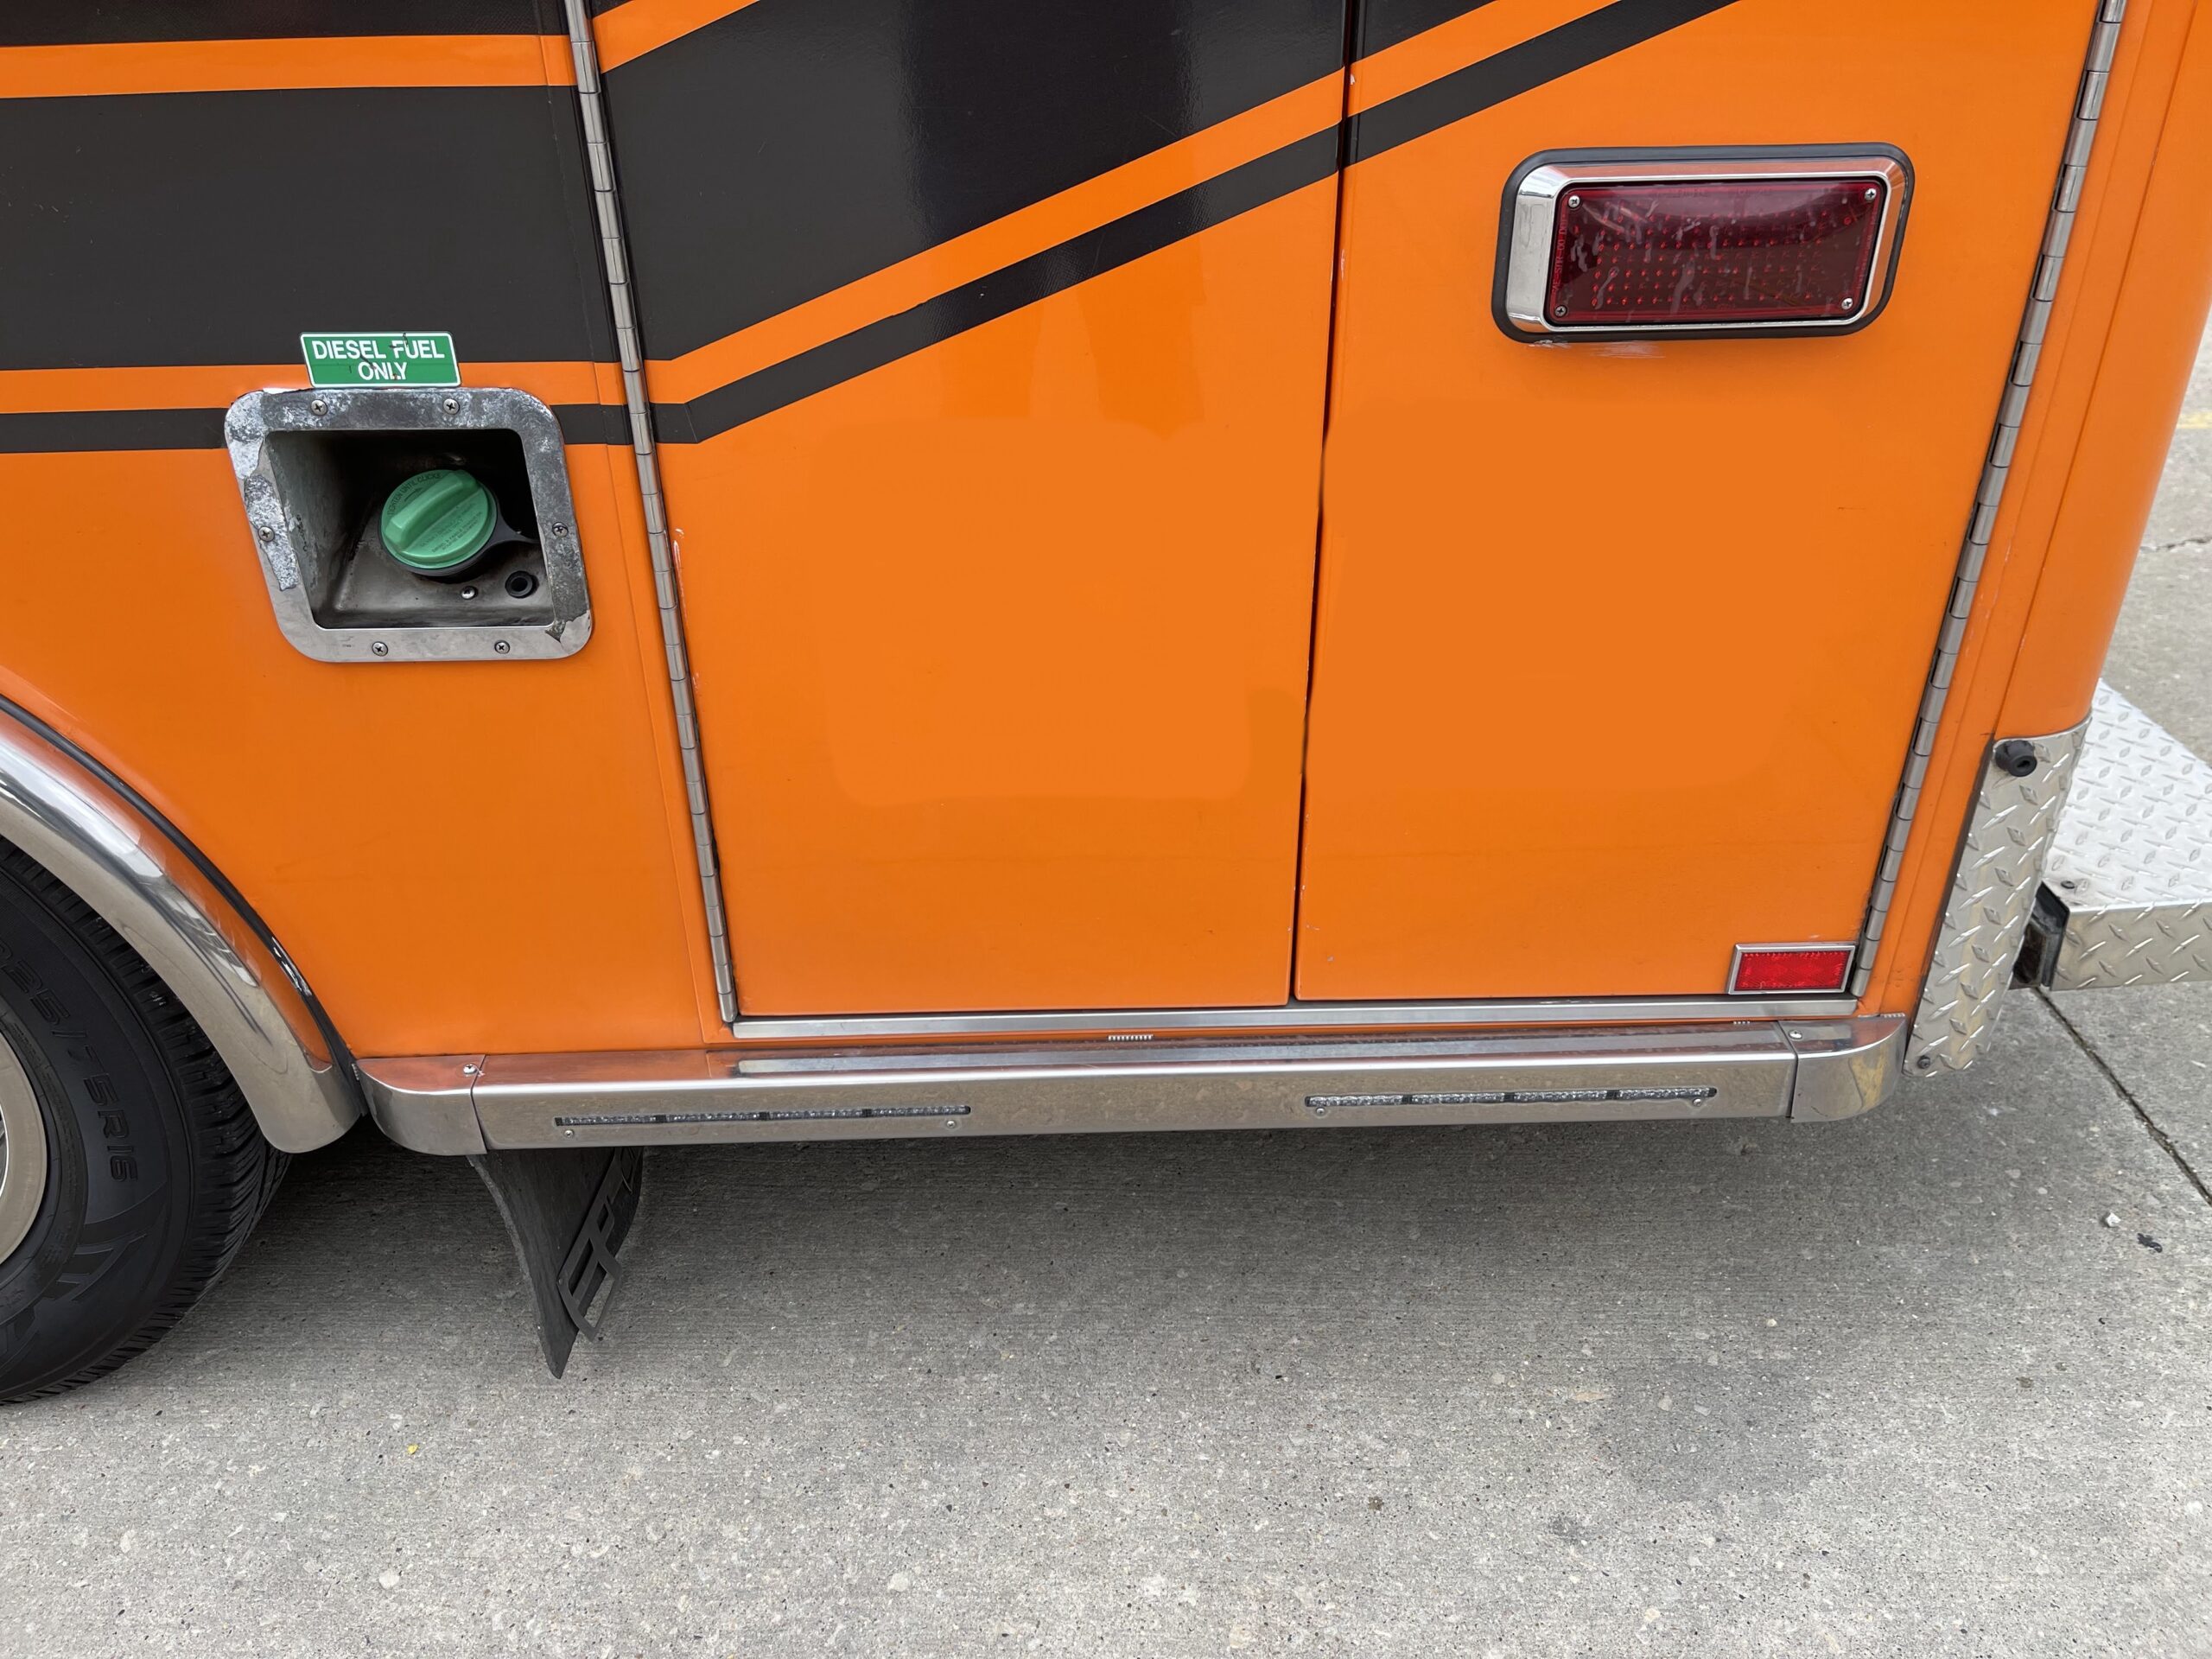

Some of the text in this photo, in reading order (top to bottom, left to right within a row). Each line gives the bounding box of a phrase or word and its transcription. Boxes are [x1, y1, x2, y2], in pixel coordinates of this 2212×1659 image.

[312, 340, 445, 359] DIESEL FUEL
[358, 361, 408, 380] ONLY
